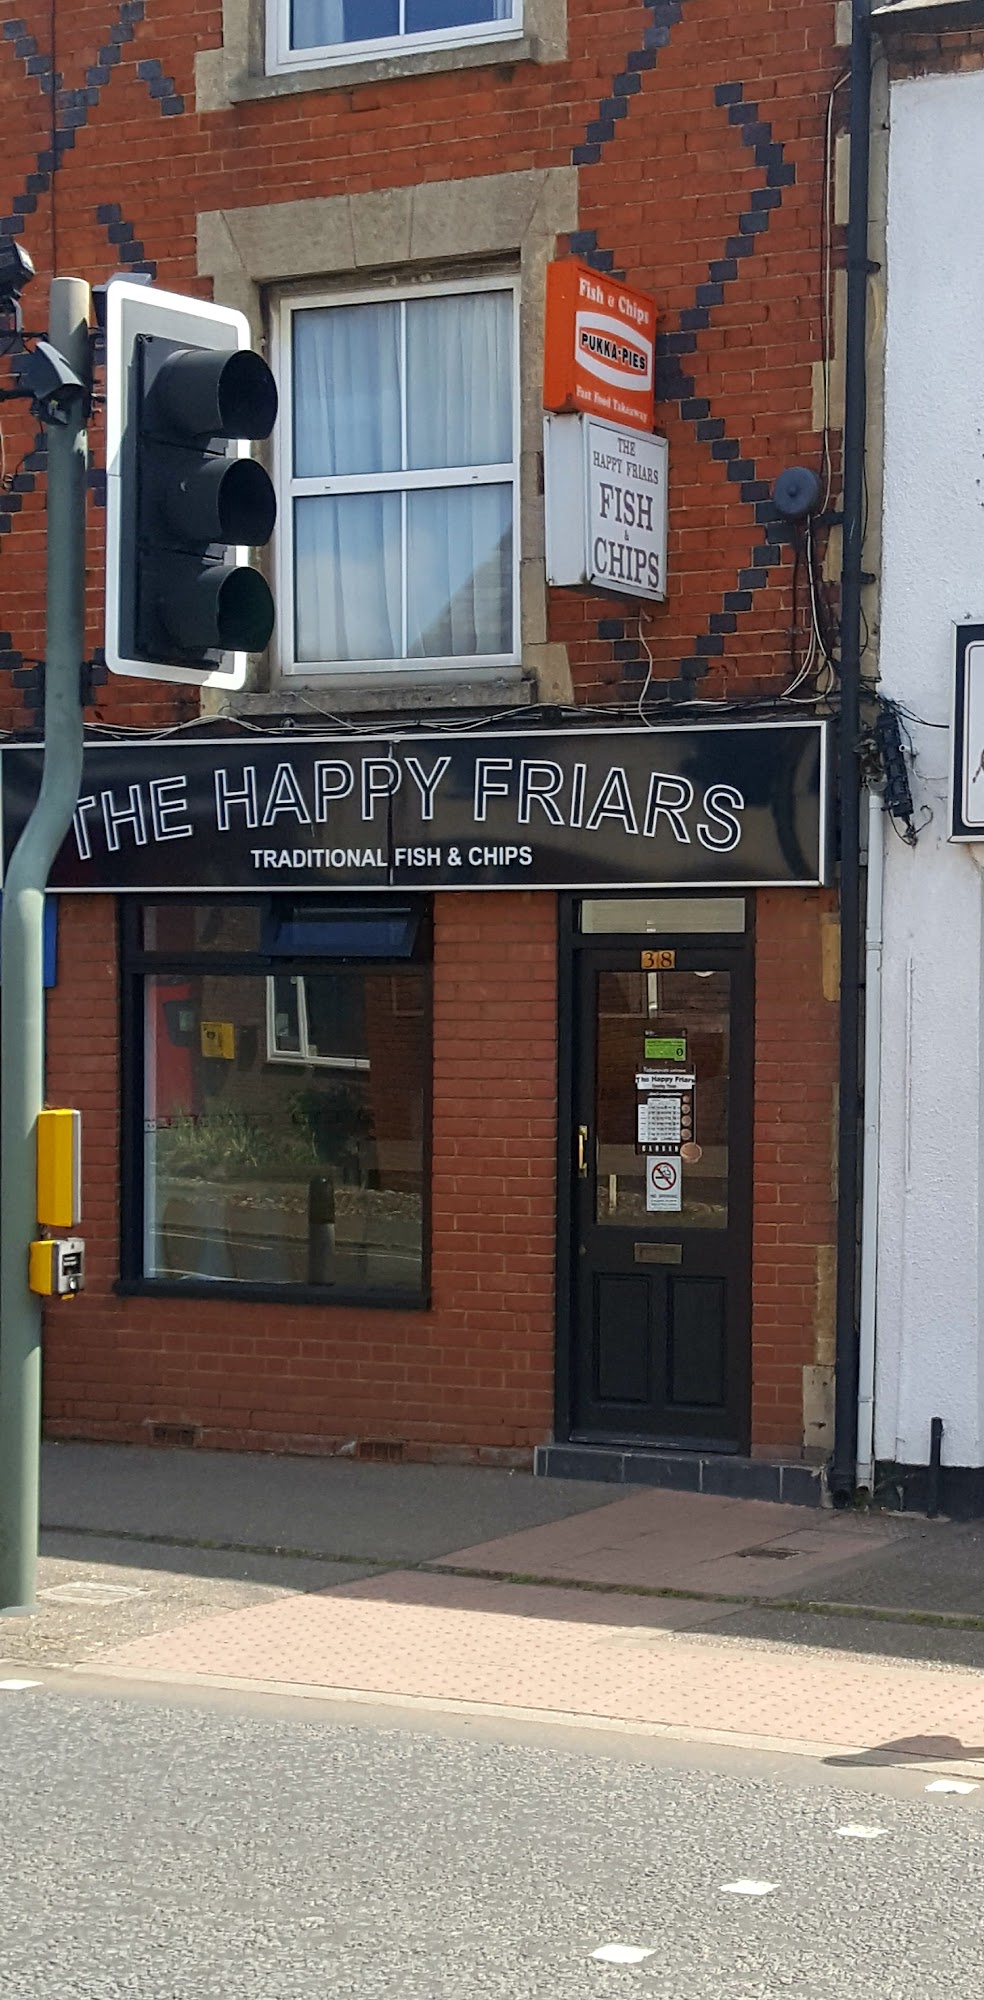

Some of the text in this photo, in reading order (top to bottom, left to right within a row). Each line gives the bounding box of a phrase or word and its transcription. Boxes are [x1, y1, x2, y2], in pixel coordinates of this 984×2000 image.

[579, 277, 604, 305] Fish
[618, 294, 649, 325] Chips
[576, 385, 648, 420] Fast Food Takeaway
[617, 437, 636, 457] THE
[593, 451, 659, 485] HAPPY FRIARS
[599, 482, 654, 532] FISH
[594, 537, 660, 588] CHIPS
[73, 756, 745, 861] THE HAPPY FRIARS
[251, 845, 534, 869] TRADITIONAL FISH & CHIPS
[644, 951, 673, 968] 38
[651, 1076, 673, 1084] Happy
